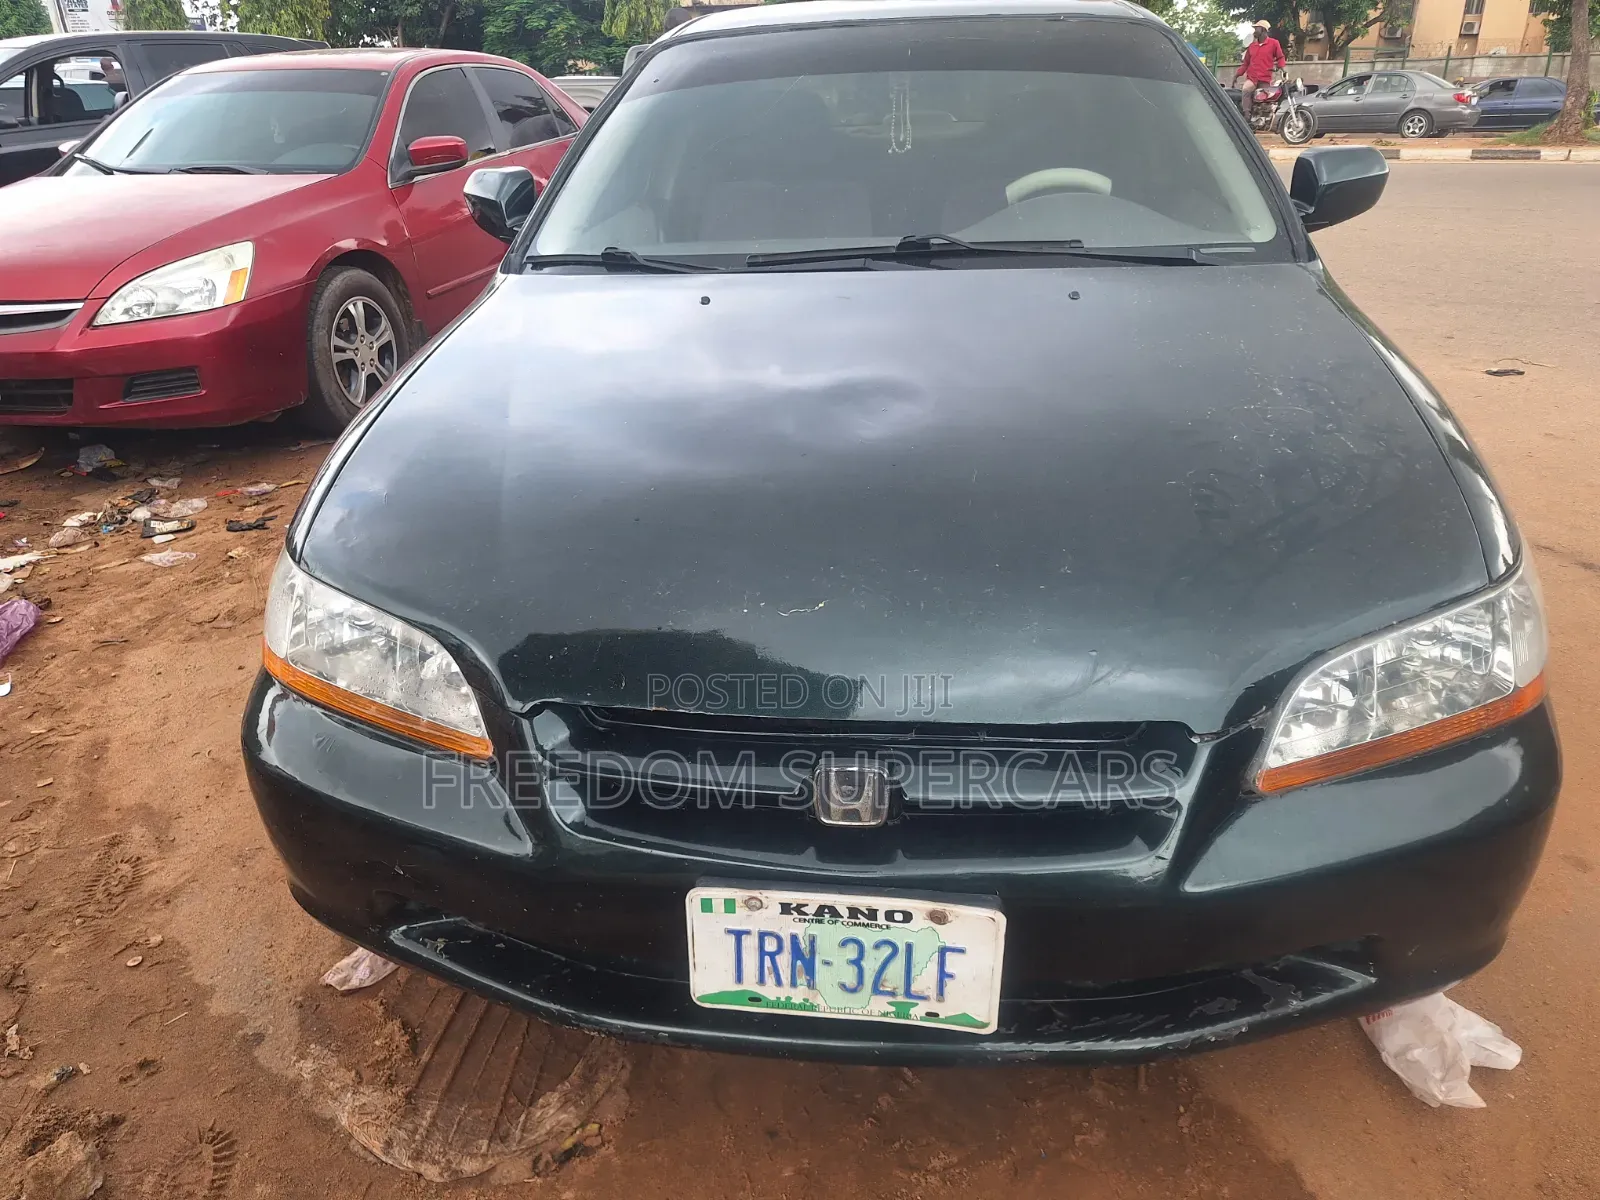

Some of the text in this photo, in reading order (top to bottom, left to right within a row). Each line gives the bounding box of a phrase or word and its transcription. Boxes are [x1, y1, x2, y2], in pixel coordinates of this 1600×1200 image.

[779, 902, 914, 924] KANO
[793, 917, 825, 925] CENTRE
[841, 920, 891, 930] COMMERCE
[725, 928, 966, 1002] TRN-32LF
[766, 1001, 921, 1021] FEDERAL REPUBLIC OF NIGERIA
